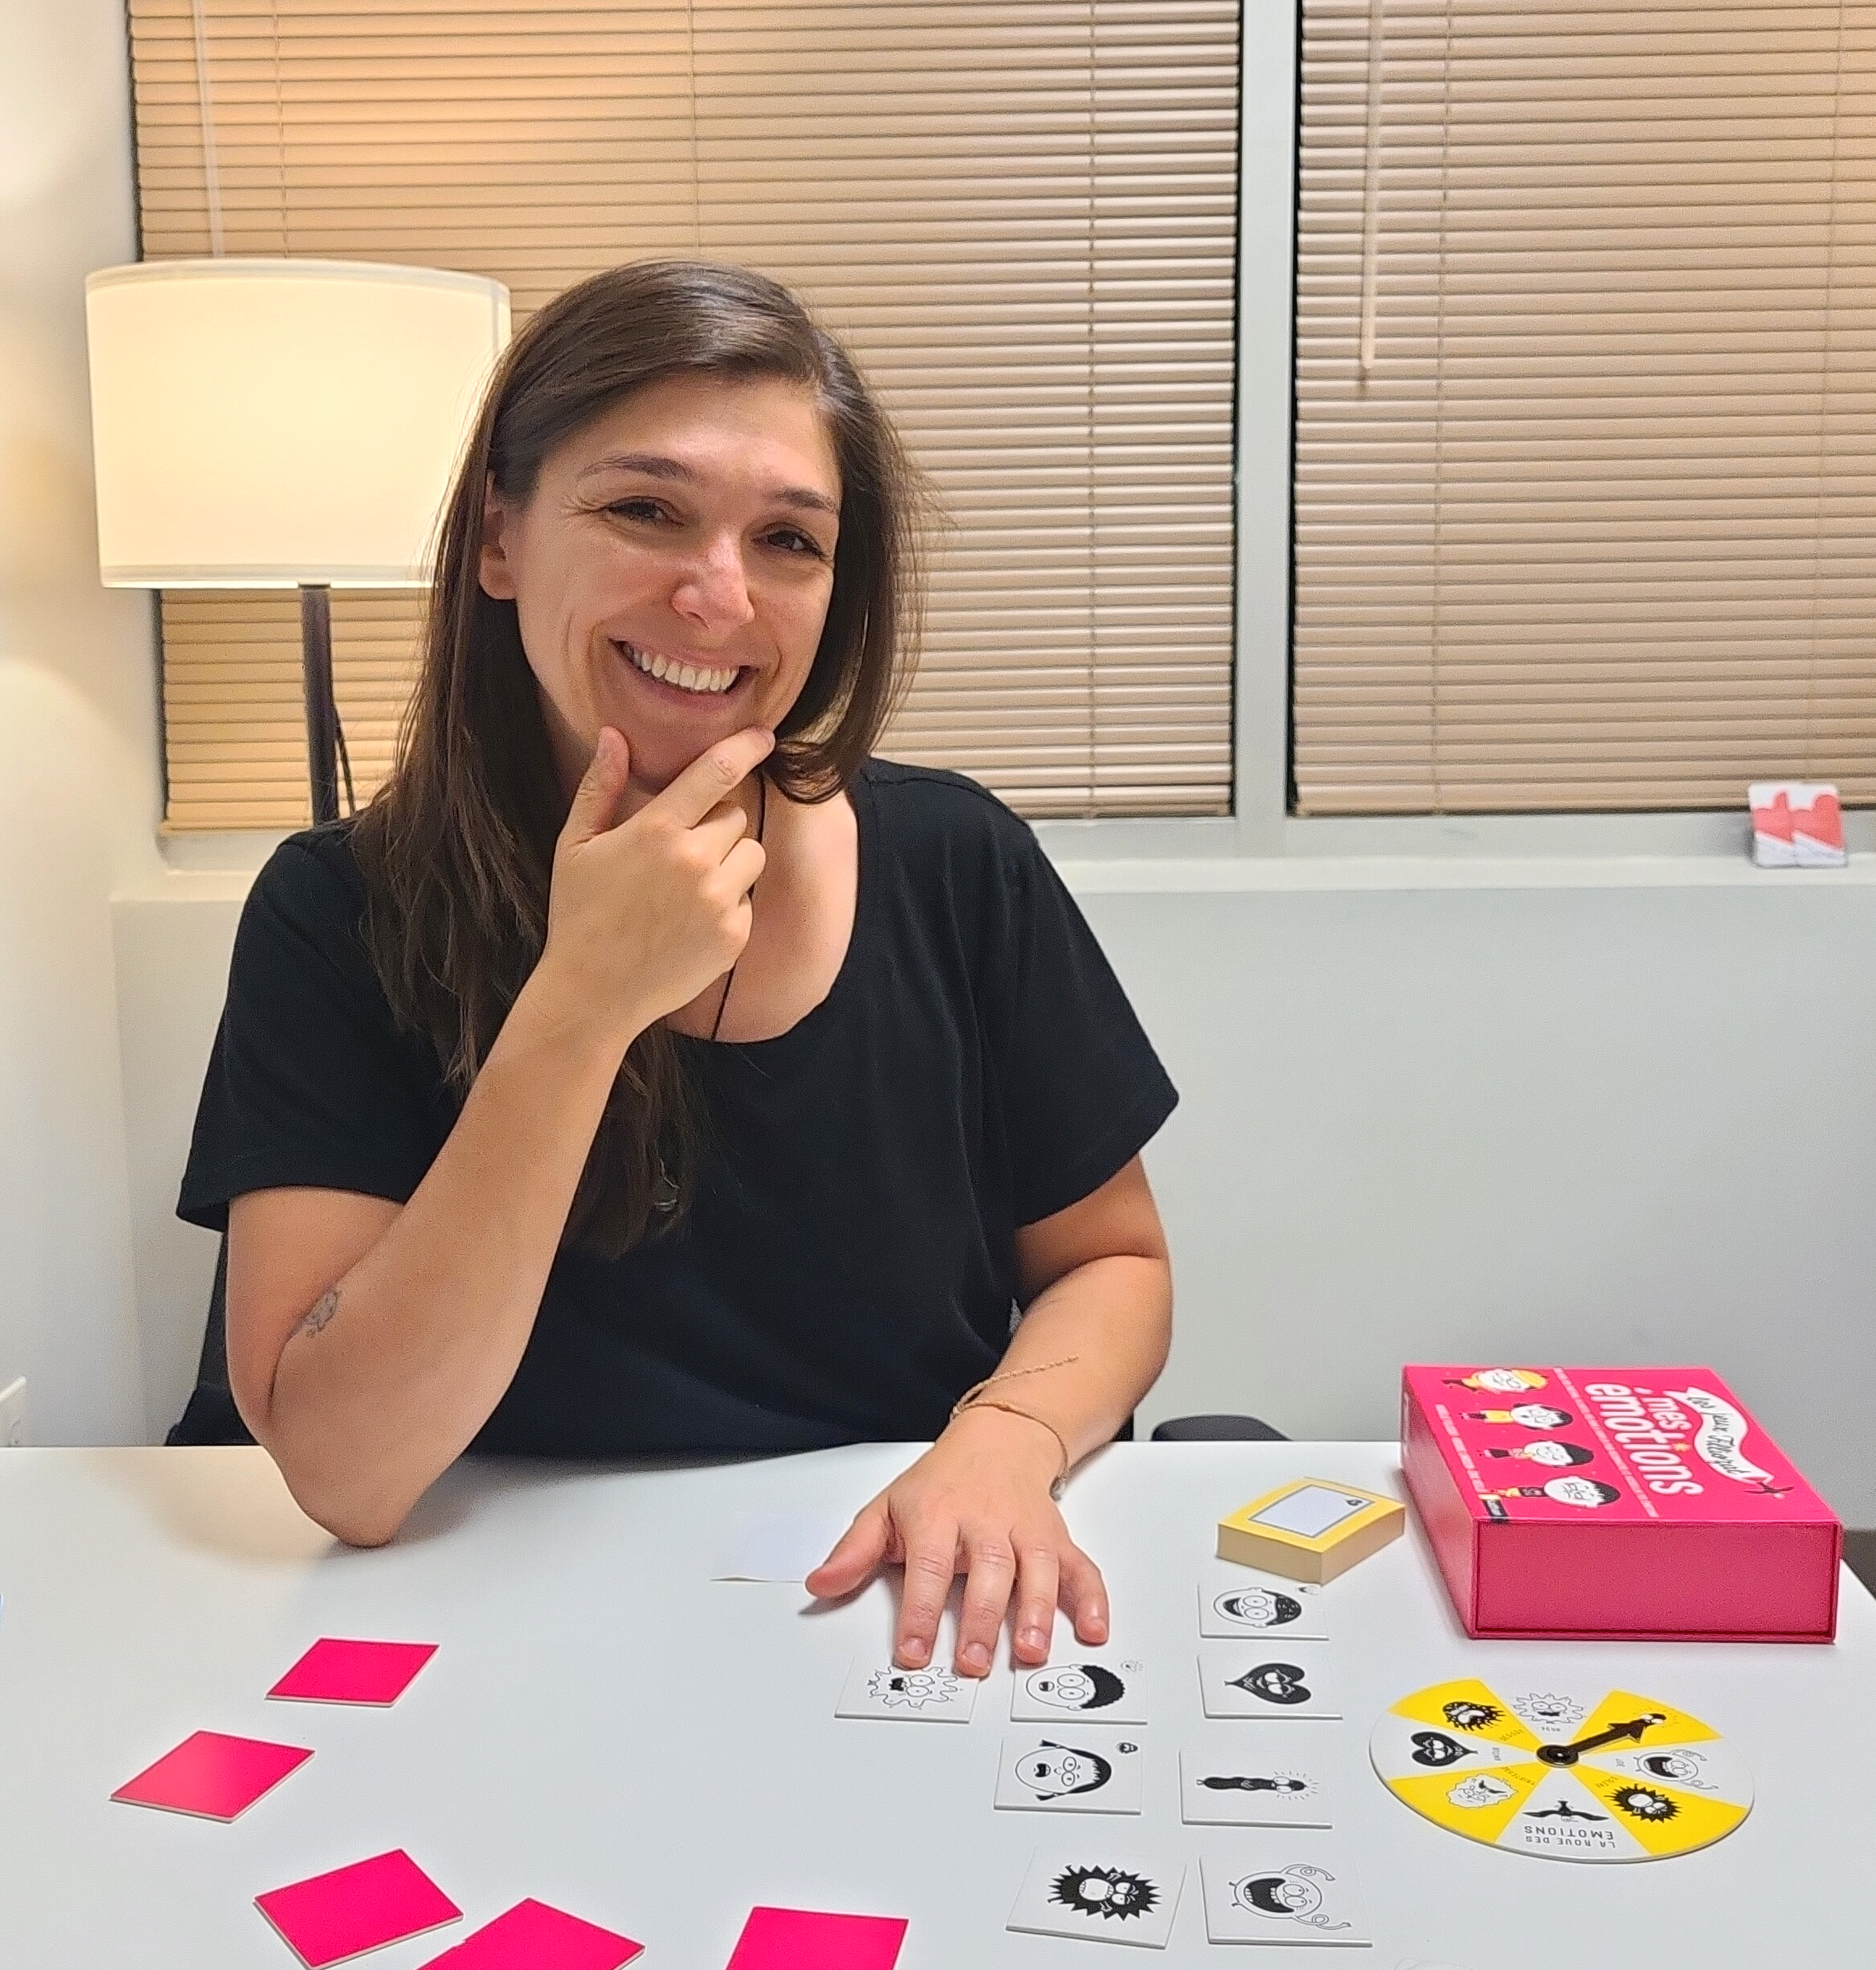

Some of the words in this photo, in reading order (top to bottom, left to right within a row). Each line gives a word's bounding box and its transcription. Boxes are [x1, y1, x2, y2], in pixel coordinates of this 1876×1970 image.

[1641, 1397, 1693, 1430] mes
[1700, 1412, 1730, 1432] jeux
[1584, 1384, 1705, 1495] émotions
[1526, 1836, 1550, 1844] DES
[1556, 1838, 1592, 1847] ROUE
[1599, 1841, 1616, 1849] LA
